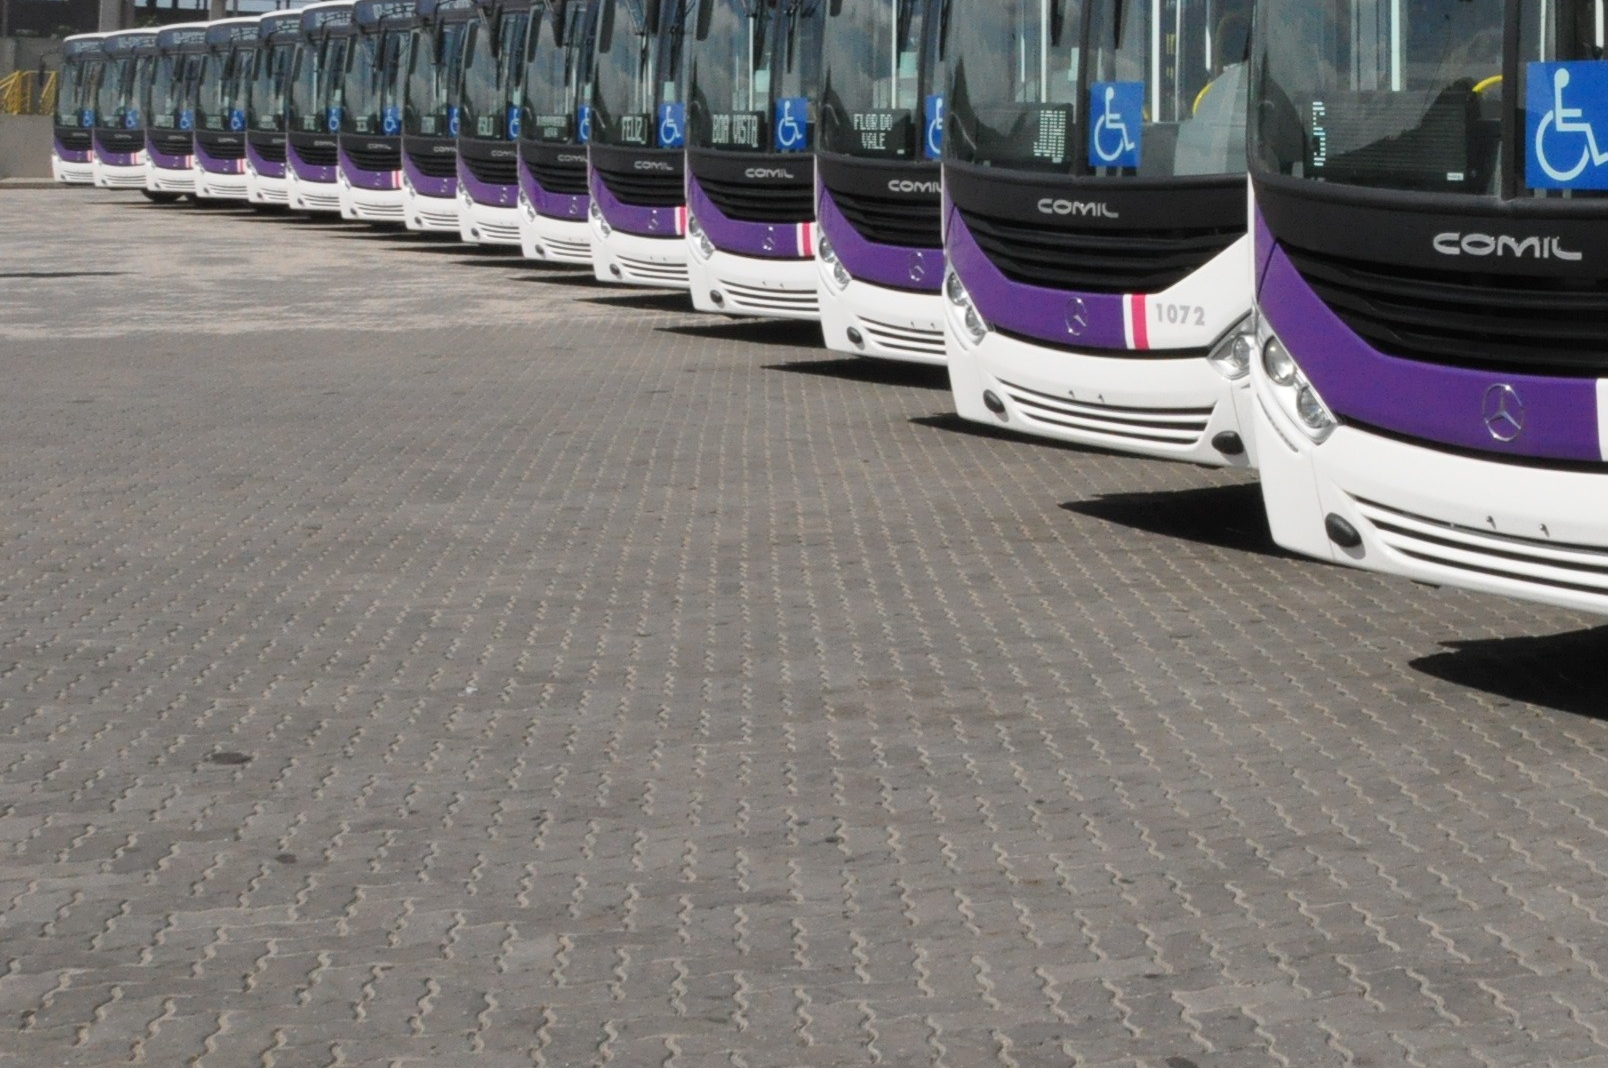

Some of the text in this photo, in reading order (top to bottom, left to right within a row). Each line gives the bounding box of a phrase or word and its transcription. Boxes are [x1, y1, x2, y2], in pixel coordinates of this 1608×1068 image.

[744, 167, 795, 179] COMIL
[1037, 198, 1119, 219] COMIL
[1432, 232, 1583, 261] COMIL
[1155, 303, 1206, 326] 1072
